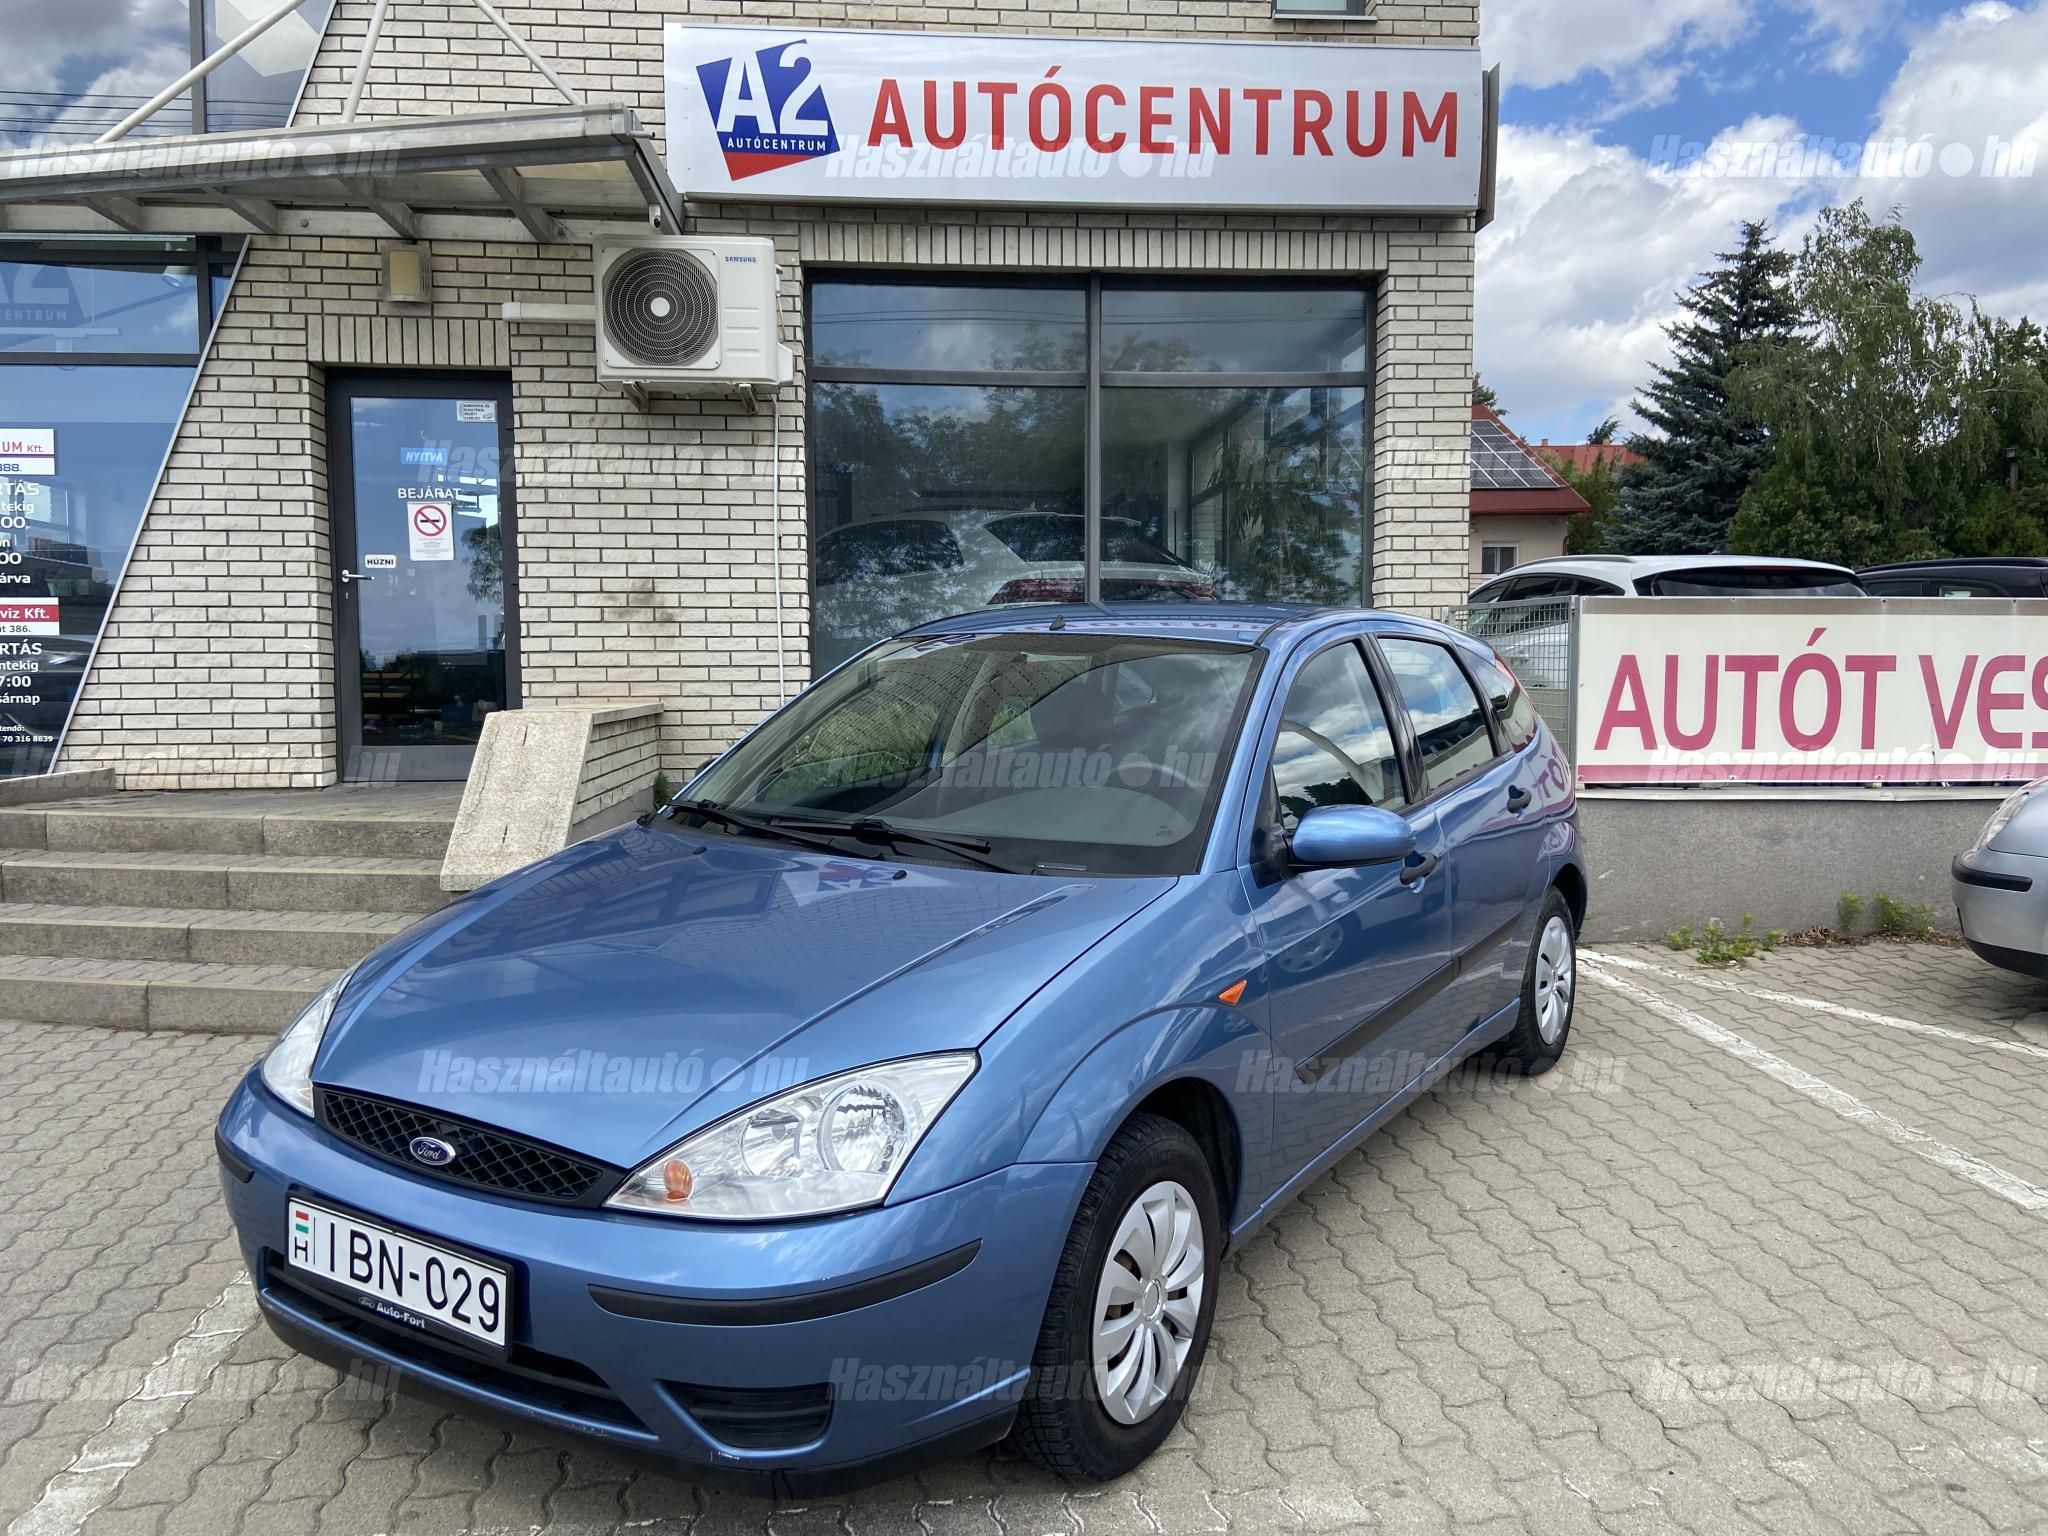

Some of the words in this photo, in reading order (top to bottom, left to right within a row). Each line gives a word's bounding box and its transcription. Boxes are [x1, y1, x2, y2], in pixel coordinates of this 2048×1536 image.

[715, 41, 828, 135] A2
[866, 65, 1457, 158] AUTÓCENTRUM
[727, 135, 827, 152] AUTÓCENTRUM
[397, 485, 462, 499] BEJÁRAT
[24, 608, 50, 619] Kft.
[9, 625, 31, 633] 386.
[1593, 627, 1898, 752] AUTÓT
[15, 735, 31, 743] 316
[33, 735, 54, 743] 8639
[417, 1141, 440, 1160] Ford
[294, 1236, 309, 1263] H
[330, 1222, 500, 1333] IBN-029
[376, 1303, 426, 1329] Auto-Fort
